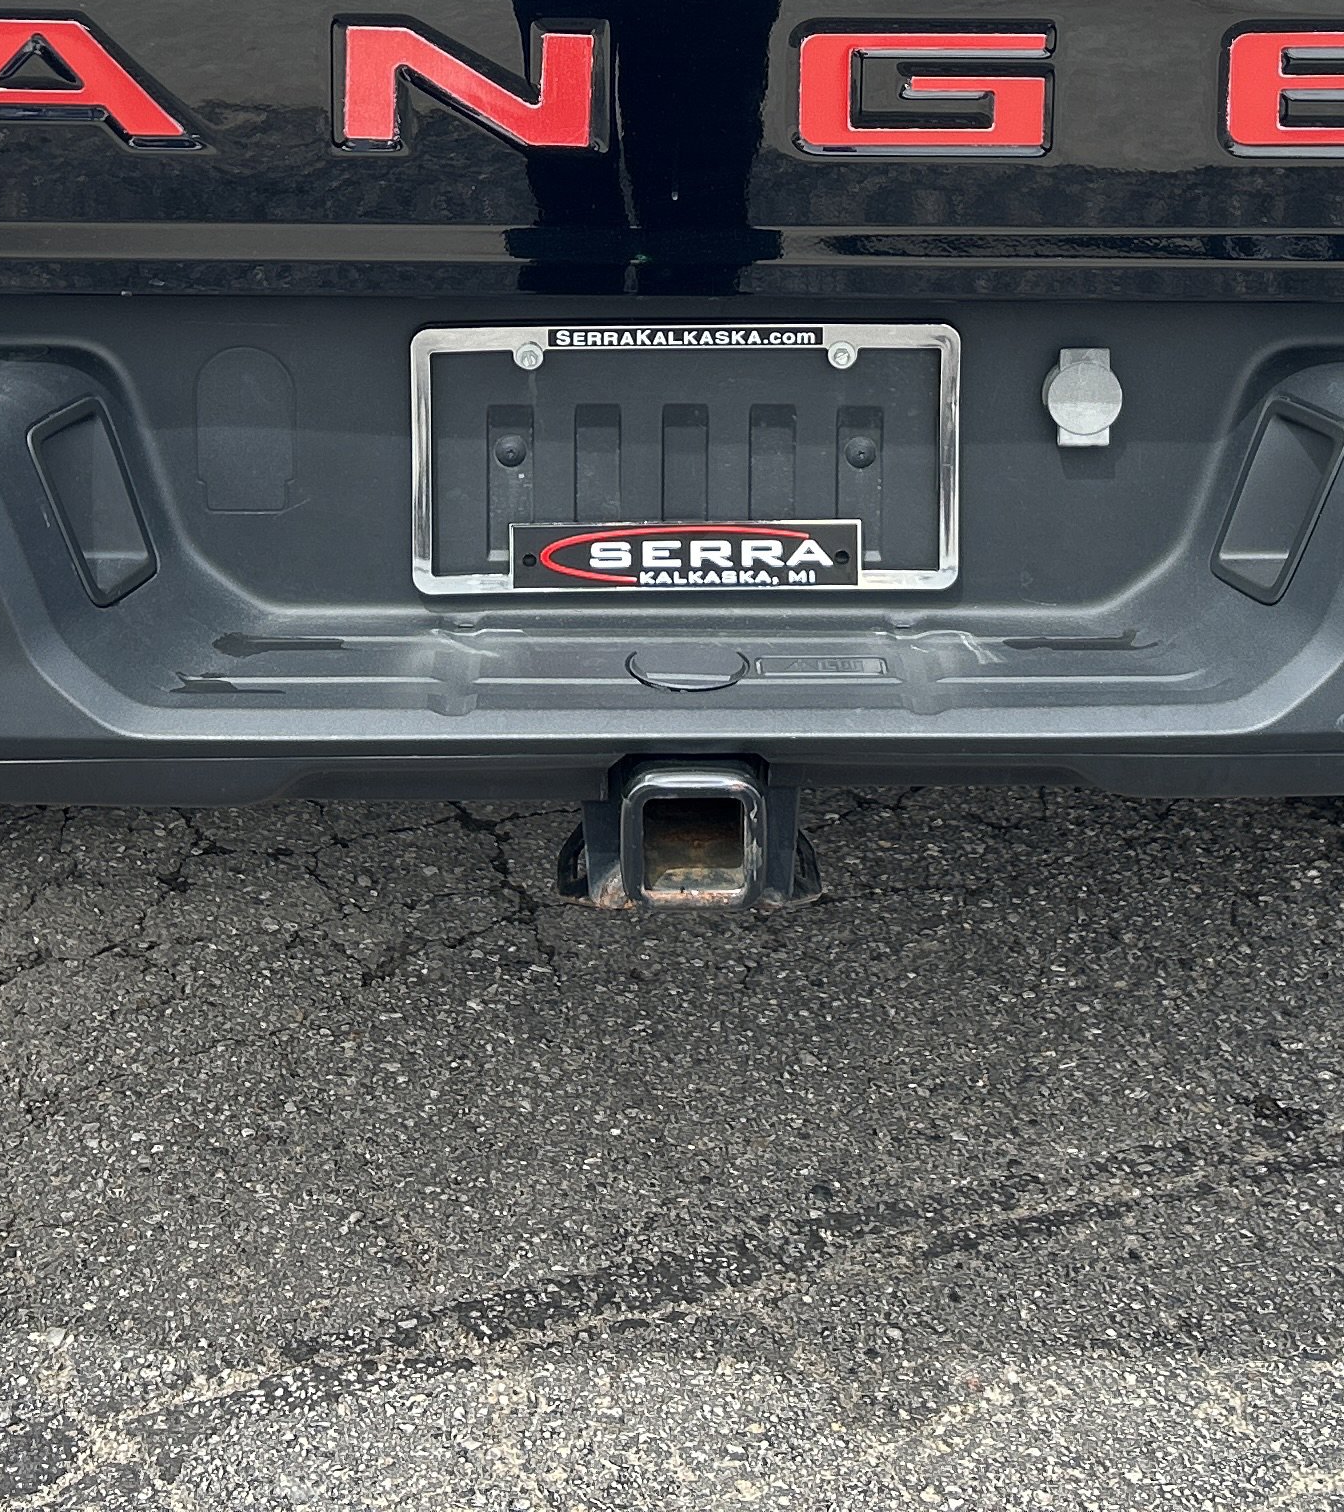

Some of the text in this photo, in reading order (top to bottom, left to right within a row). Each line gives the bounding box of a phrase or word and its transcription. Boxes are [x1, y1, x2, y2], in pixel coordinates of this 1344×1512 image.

[556, 329, 816, 346] SERRAKALKASKA.com
[589, 539, 834, 568] SERRA
[639, 569, 816, 585] KALKASKA, MI
